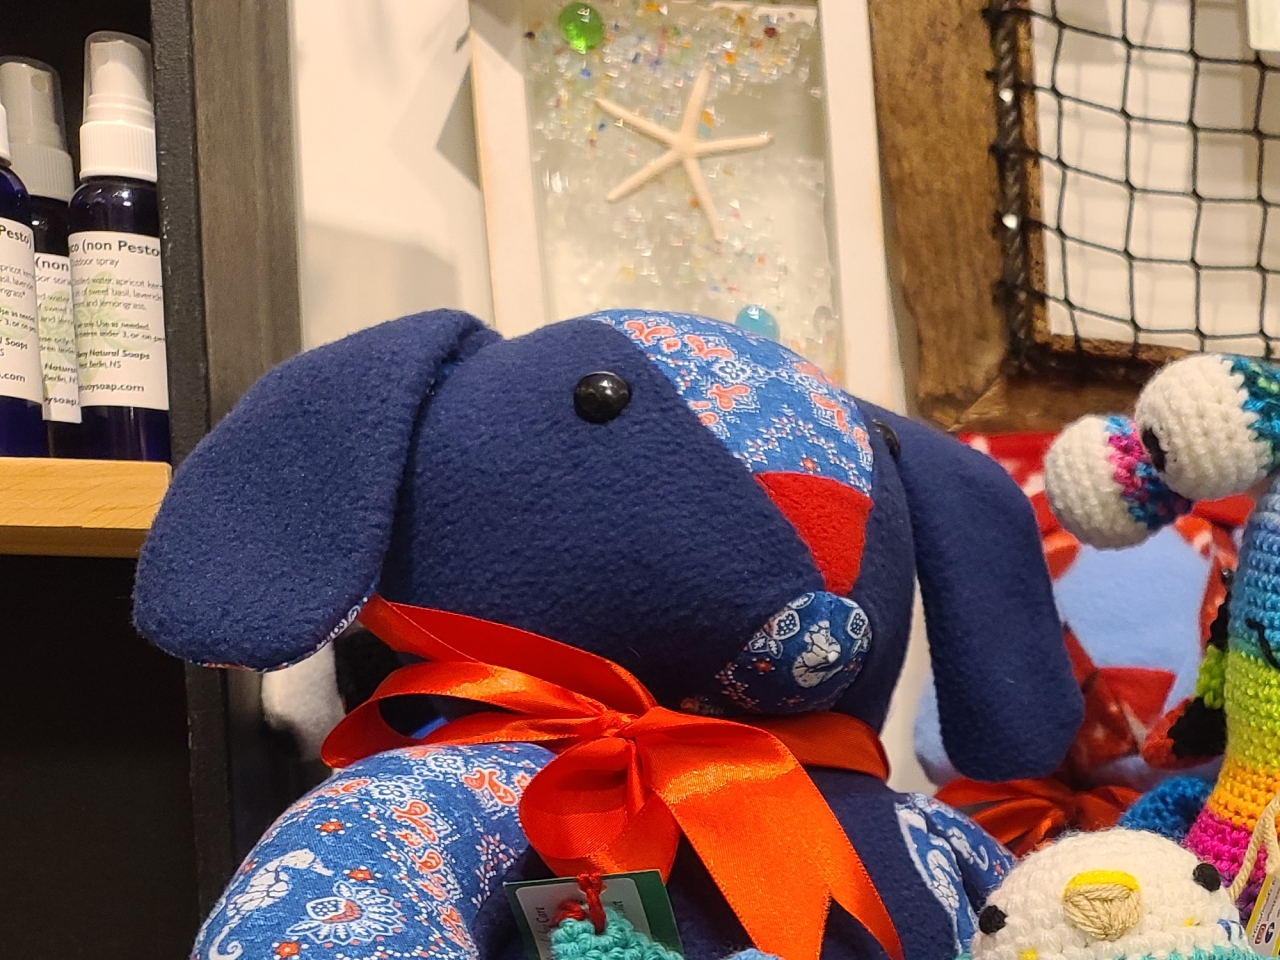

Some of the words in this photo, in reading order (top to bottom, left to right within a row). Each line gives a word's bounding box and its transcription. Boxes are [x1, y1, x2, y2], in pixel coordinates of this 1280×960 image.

[82, 239, 112, 254] (non
[35, 256, 69, 272] (non
[89, 349, 119, 357] Natural
[121, 350, 150, 361] Soaps
[0, 372, 26, 382] .com
